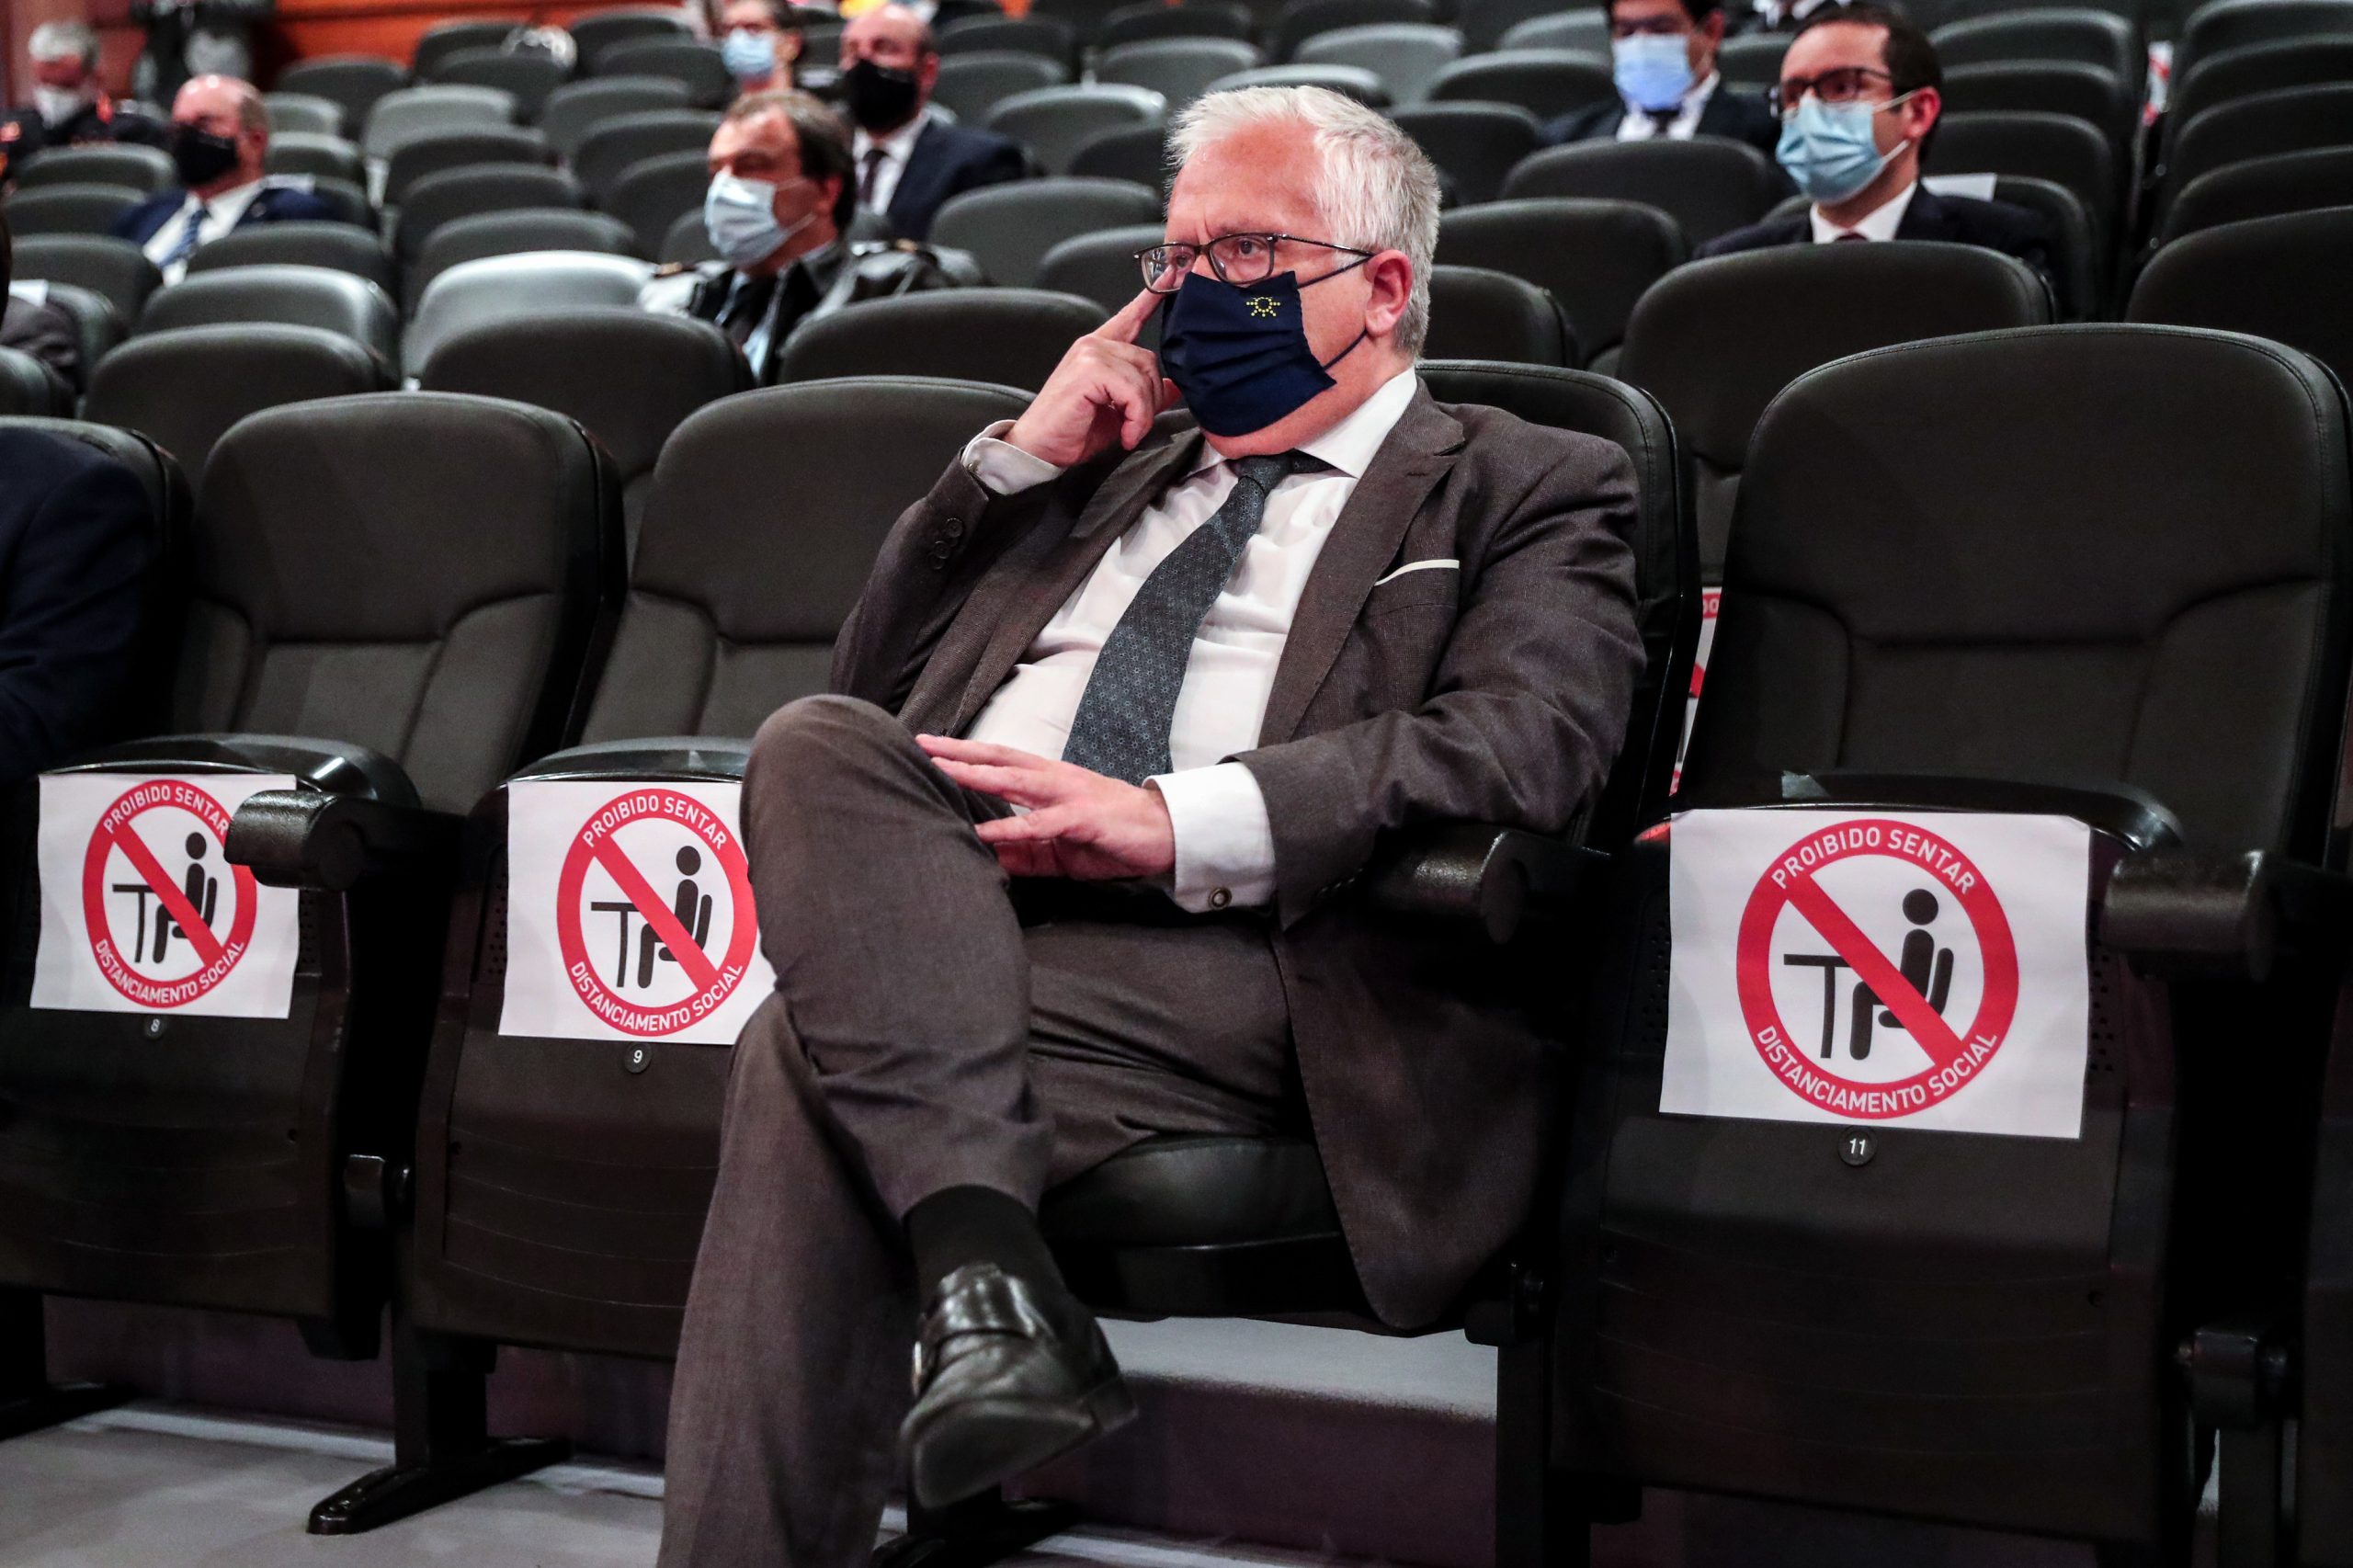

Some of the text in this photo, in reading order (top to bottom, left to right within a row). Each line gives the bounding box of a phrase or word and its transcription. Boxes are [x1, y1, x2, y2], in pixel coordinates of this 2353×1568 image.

[103, 784, 230, 835] PROIBIDO SENTAR
[582, 795, 727, 849] PROIBIDO SENTAR
[1771, 826, 1975, 894] PROIBIDO SENTAR
[96, 938, 244, 1004] DISTANCIAMENTO SOCIAL
[571, 960, 743, 1031] DISTANCIAMENTO SOCIAL
[151, 1018, 160, 1032] 8
[633, 1050, 642, 1063] 9
[1757, 1025, 1997, 1113] DISTANCIAMENTO SOCIAL
[1849, 1138, 1866, 1155] 11
